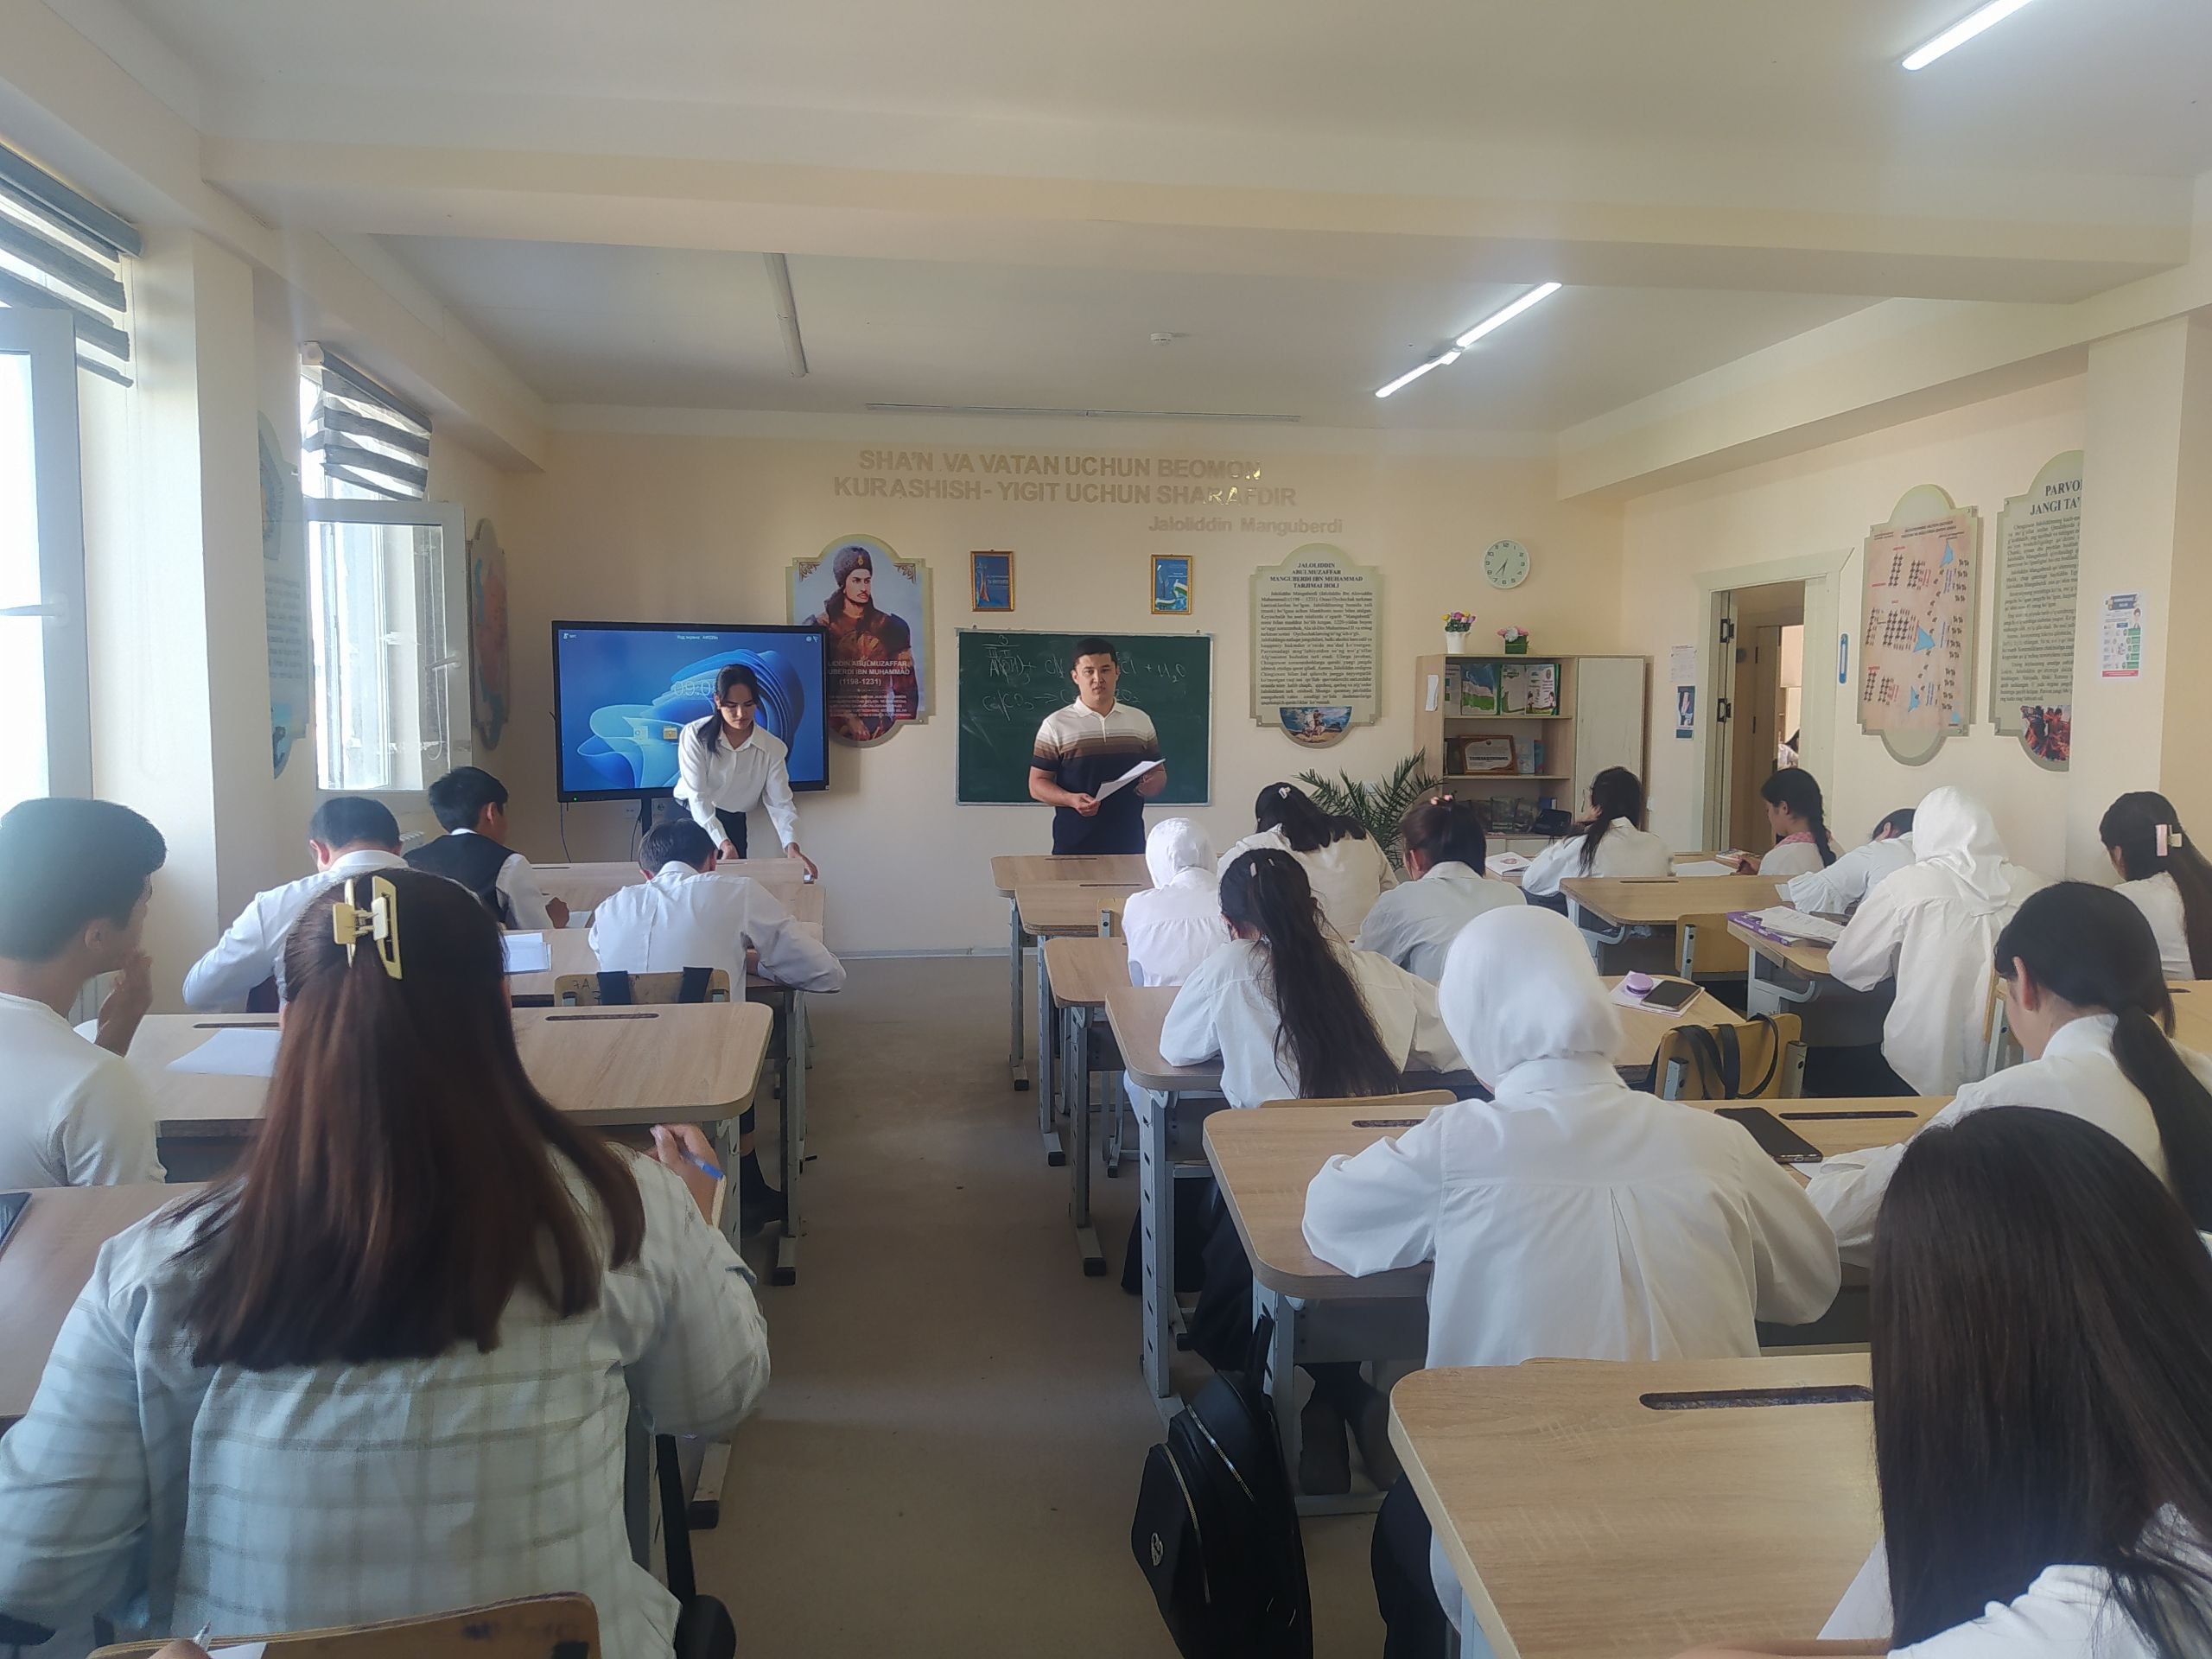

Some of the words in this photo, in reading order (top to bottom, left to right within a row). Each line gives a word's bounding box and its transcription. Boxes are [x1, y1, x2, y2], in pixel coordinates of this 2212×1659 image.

[943, 453, 975, 473] VA
[979, 454, 1059, 475] VATAN
[1065, 456, 1150, 477] UCHUN
[997, 481, 1060, 502] YIGIT
[1065, 483, 1150, 504] UCHUN
[1156, 485, 1297, 506] SHARAFDIR
[2045, 477, 2082, 496] PARVO
[2030, 499, 2061, 515] JANGI
[2063, 496, 2081, 510] TA'
[1148, 516, 1232, 532] Jaloliddin
[1240, 517, 1343, 537] Manguberdi
